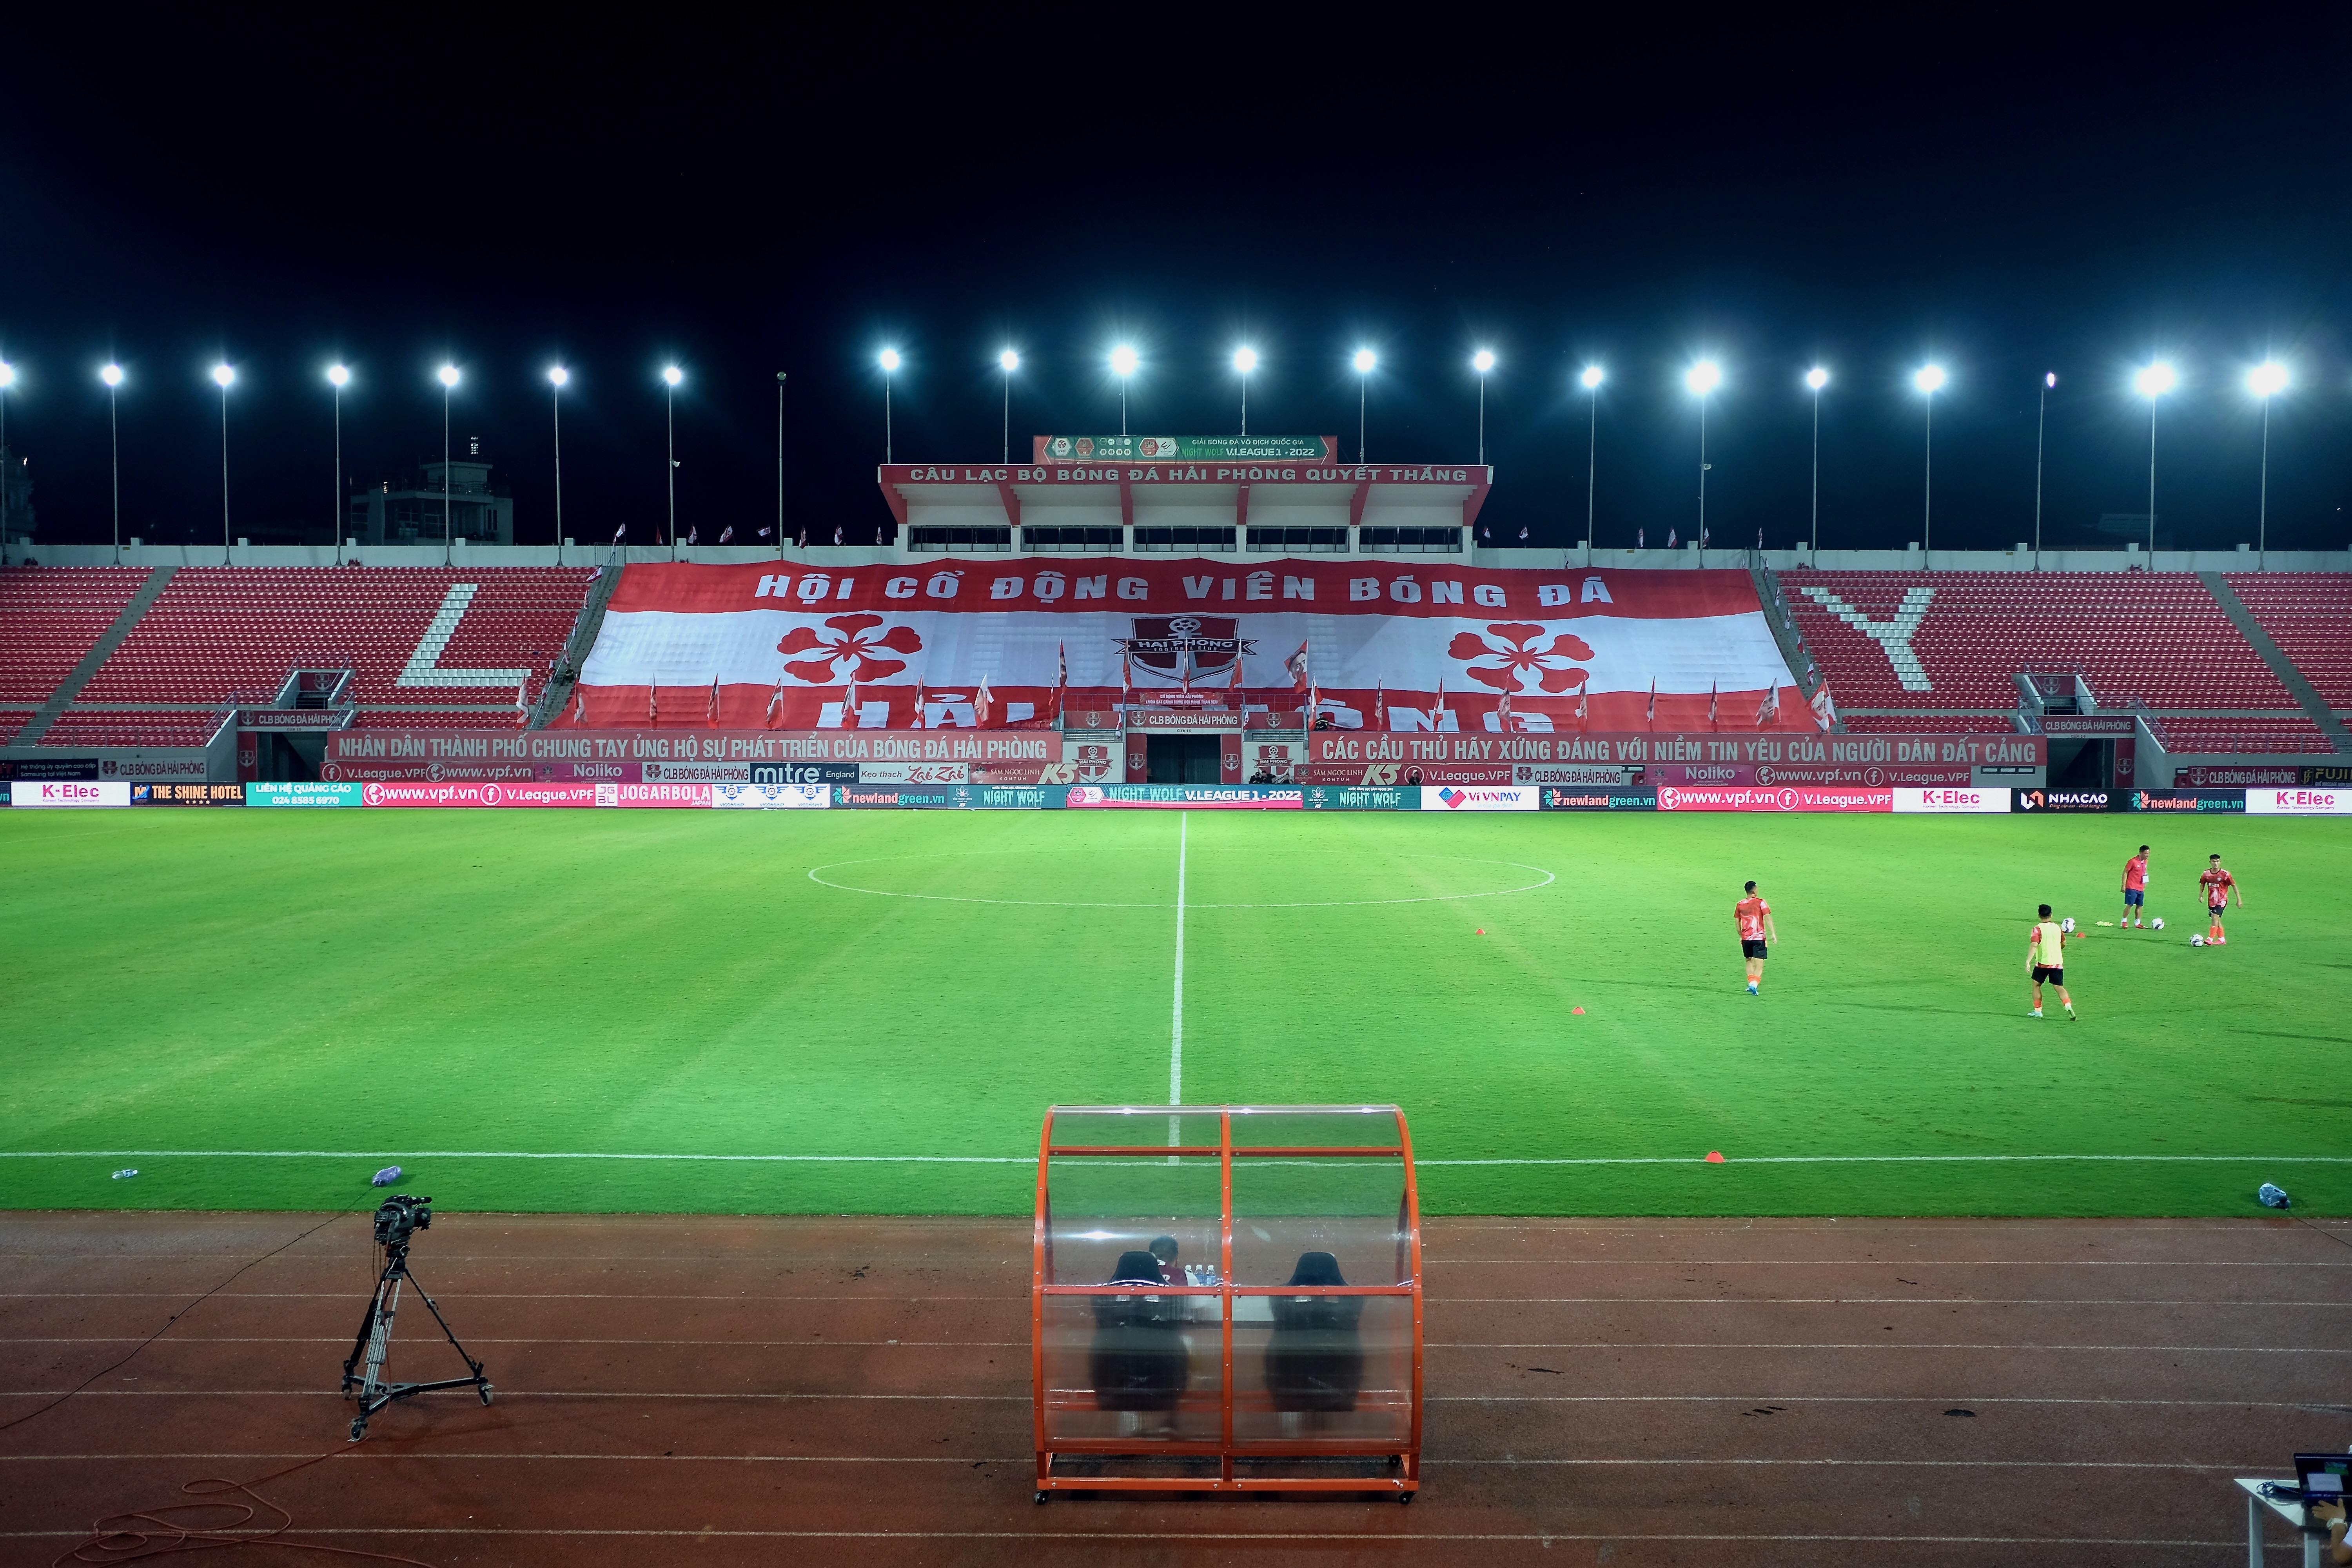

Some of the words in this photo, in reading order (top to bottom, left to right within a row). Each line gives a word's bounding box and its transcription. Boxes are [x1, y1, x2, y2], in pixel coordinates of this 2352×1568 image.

[1182, 448, 1202, 457] NIGHT
[1205, 448, 1224, 457] WOLF
[911, 467, 955, 480] CÂU
[965, 469, 1007, 482] LẠC
[1018, 467, 1047, 482] BỘ
[1058, 467, 1119, 480] BÓNG
[1128, 467, 1159, 480] ĐÁ
[1169, 466, 1206, 480] HẢI
[1217, 466, 1295, 480] PHÒNG
[1306, 465, 1381, 481] QUYẾT
[1389, 466, 1466, 481] THẮNG
[755, 573, 855, 604] HỘI
[885, 570, 965, 599] CỔ
[989, 570, 1148, 604] ĐỘNG
[1183, 571, 1314, 601] VIÊN
[1350, 575, 1507, 607] BÓNG
[1538, 577, 1613, 607] ĐÁ
[1149, 716, 1164, 725] CLB
[1165, 714, 1187, 725] BÓNG
[1187, 714, 1198, 725] ĐÁ
[1199, 714, 1210, 725] HẢI
[1212, 714, 1238, 725] PHÒNG
[339, 734, 385, 756] NHÂN
[391, 734, 425, 757] DÂN
[430, 734, 486, 757] THÀNH
[492, 732, 528, 757] PHỐ
[532, 739, 591, 757] CHUNG
[595, 739, 628, 757] TAY
[633, 733, 668, 757] ỦNG
[674, 735, 698, 761] HỘ
[703, 737, 727, 761] SỰ
[731, 735, 775, 757] PHÁT
[779, 731, 828, 758] TRIỂN
[834, 734, 868, 758] CỦA
[874, 735, 920, 758] BÓNG
[924, 736, 949, 758] ĐÁ
[954, 735, 981, 759] HẢI
[987, 736, 1046, 759] PHÒNG
[1322, 736, 1359, 760] CÁC
[1366, 734, 1403, 760] CẦU
[1410, 735, 1447, 760] THỦ
[1455, 737, 1492, 760] HÃY
[1498, 736, 1550, 760] XỨNG
[1557, 737, 1609, 760] ĐÁNG
[1616, 737, 1647, 760] VỚI
[1655, 735, 1701, 761] NIỀM
[1708, 742, 1738, 761] TIN
[1745, 738, 1781, 761] YÊU
[1788, 736, 1826, 761] CỦA
[1833, 739, 1891, 762] NGƯỜI
[1899, 739, 1936, 762] DÂN
[1942, 737, 1979, 762] ĐẤT
[1985, 737, 2035, 762] CẢNG
[120, 764, 134, 775] CLB
[136, 761, 155, 775] BÓNG
[157, 760, 167, 775] ĐÁ
[168, 761, 178, 775] HẢI
[180, 760, 204, 775] PHÒNG
[446, 765, 531, 781] www.vpf.vn
[573, 764, 622, 777] Noliko
[664, 768, 678, 780] CLB
[679, 766, 699, 780] BÓNG
[700, 766, 711, 780] ĐÁ
[711, 766, 722, 780] HẢI
[724, 766, 748, 780] PHÒNG
[755, 764, 819, 783] mitre
[826, 771, 854, 779] England
[861, 771, 877, 779] Kẹo
[880, 771, 902, 779] thạch
[1037, 764, 1079, 784] K5
[1360, 764, 1402, 785] K5
[1686, 766, 1735, 779] Noliko
[1535, 770, 1548, 782] CLB
[1550, 768, 1570, 782] BÓNG
[1571, 769, 1581, 783] ĐÁ
[1583, 769, 1594, 783] HẢI
[1595, 769, 1620, 784] PHÒNG
[1776, 768, 1861, 784] www.vpf.vn
[2209, 771, 2223, 784] CLB
[2225, 769, 2245, 784] BÓNG
[2246, 769, 2256, 784] ĐÁ
[2258, 769, 2269, 784] HẢI
[2270, 769, 2296, 784] PHÒNG
[42, 784, 99, 798] K-Elec
[152, 785, 172, 799] THE
[175, 785, 207, 799] SHINE
[211, 785, 243, 799] HOTEL
[256, 782, 277, 793] LIÊN
[279, 782, 292, 795] HỆ
[294, 782, 329, 794] QUẢNG
[330, 782, 352, 793] CÁO
[385, 785, 477, 803] www.vpf.vn
[620, 785, 711, 800] JOGARBOLA
[1109, 787, 1145, 802] NIGHT
[1150, 787, 1183, 803] WOLF
[1185, 790, 1250, 801] V.LEAGUE
[1252, 790, 1259, 801] 1
[1269, 790, 1302, 801] 2022
[272, 796, 290, 804] 024
[291, 796, 314, 804] 8585
[853, 793, 944, 806] newlandgreen.vn
[983, 790, 1014, 807] NIGHT
[1017, 791, 1045, 808] WOLF
[1339, 791, 1370, 808] NIGHT
[1373, 792, 1401, 808] WOLF
[1468, 792, 1480, 801] Ví
[1483, 792, 1521, 801] VNPAY
[1563, 795, 1655, 808] newlandgreen.vn
[1681, 790, 1774, 808] www.vpf.vn
[1923, 791, 1980, 804] K-Elec
[2277, 792, 2334, 805] K-Elec
[2151, 798, 2243, 811] newlandgreen.vn
